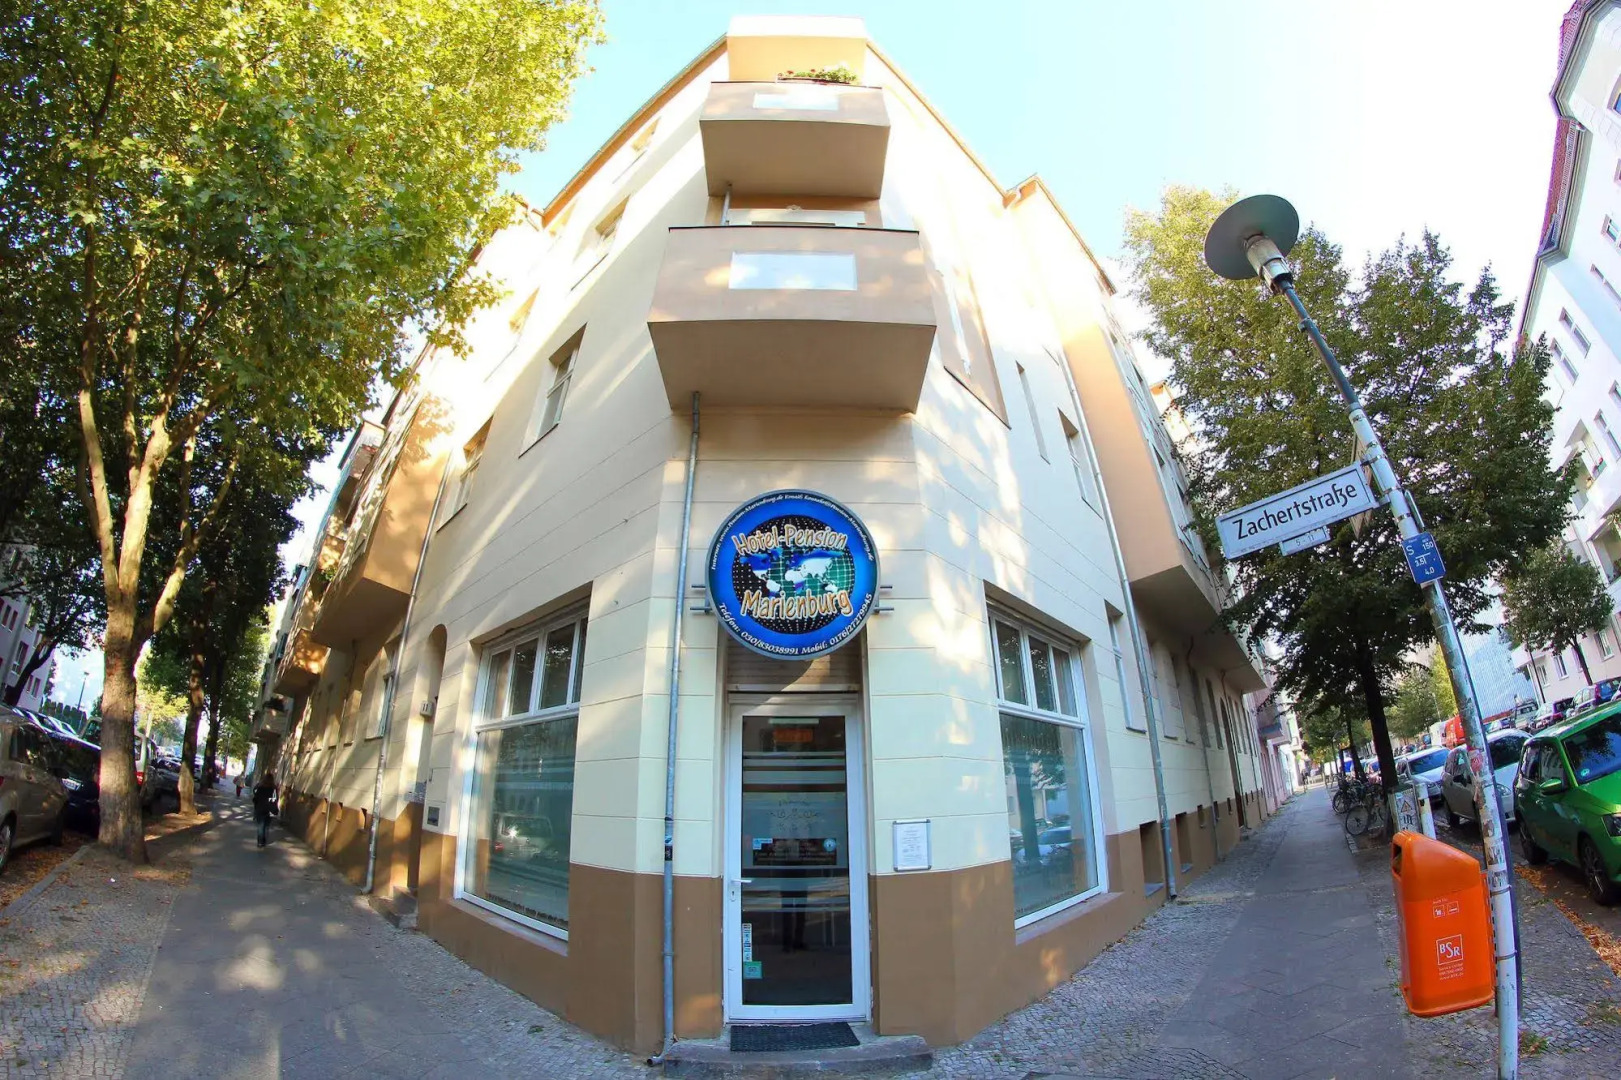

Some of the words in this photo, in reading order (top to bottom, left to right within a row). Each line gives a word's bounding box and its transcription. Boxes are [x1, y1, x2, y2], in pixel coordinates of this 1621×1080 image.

[1232, 483, 1358, 540] Zachertstraße
[732, 524, 848, 556] Hotel-Pension
[1405, 545, 1415, 556] S
[1422, 541, 1434, 551] 150
[741, 590, 854, 619] Marienburg
[718, 602, 741, 633] Telefon:
[740, 631, 799, 655] 030/83038991
[801, 640, 828, 655] Mobil:
[1439, 942, 1461, 959] BSR
